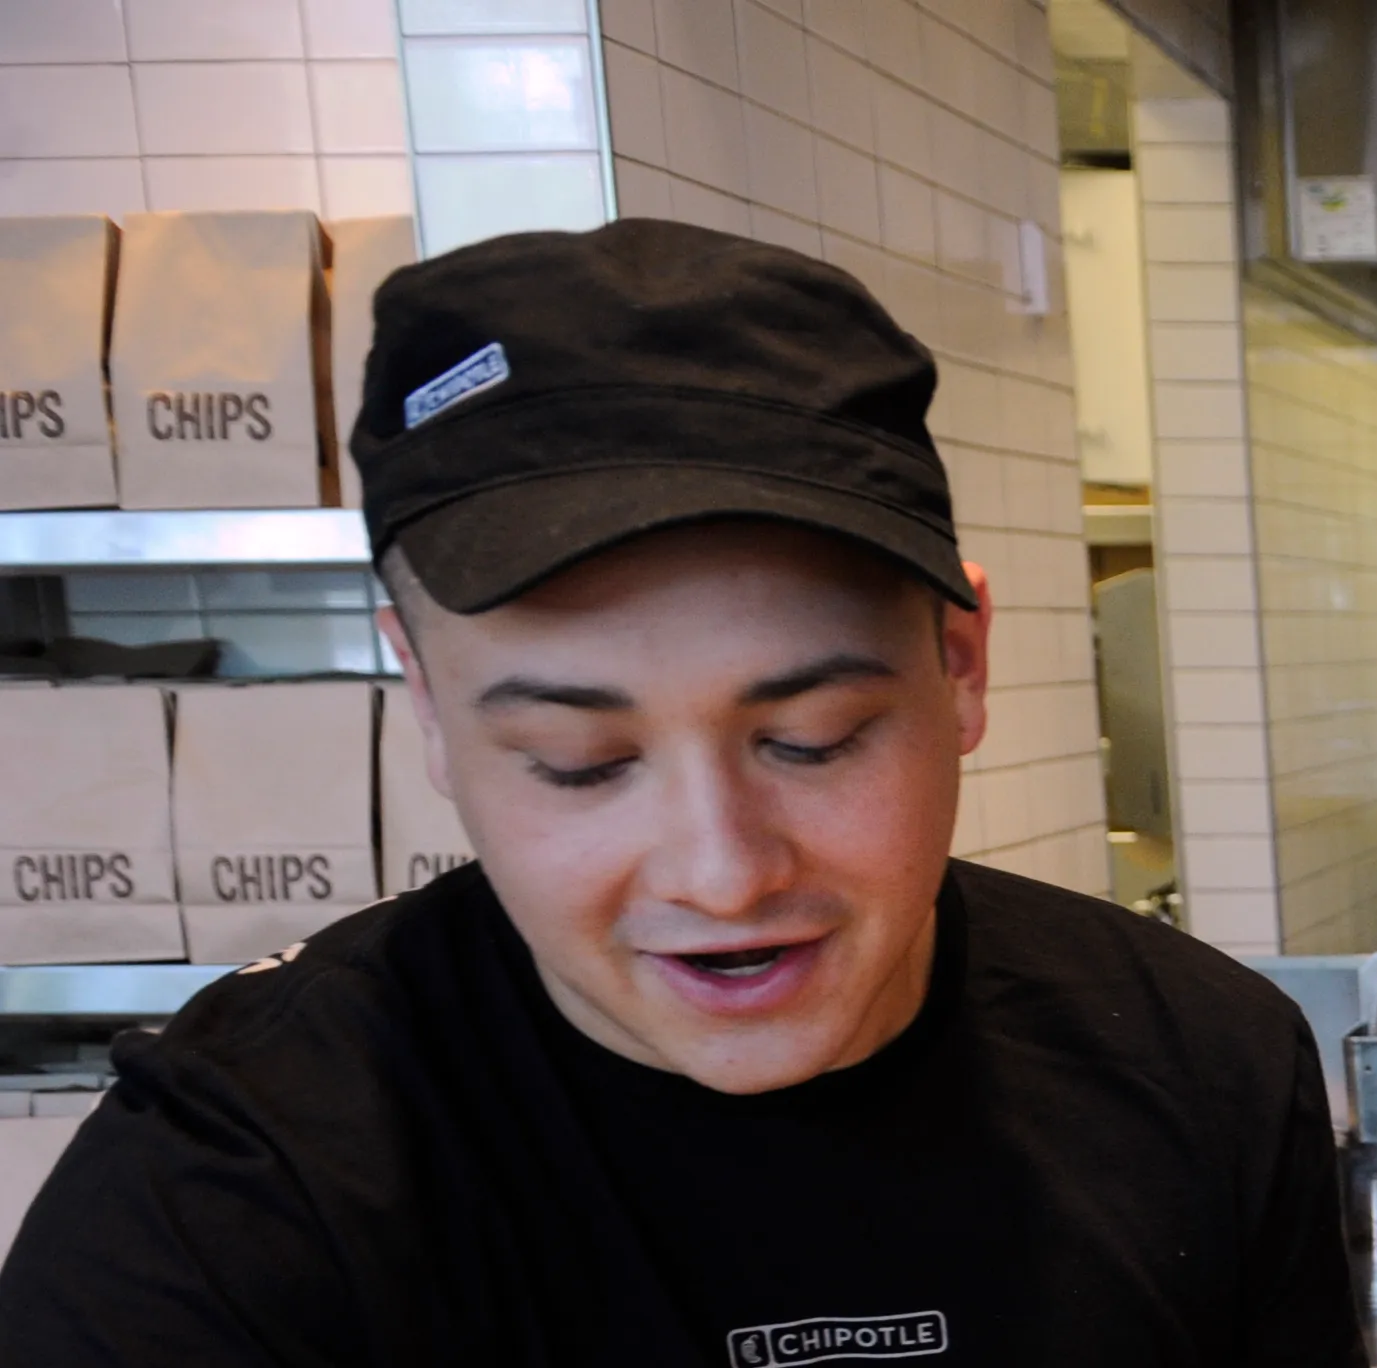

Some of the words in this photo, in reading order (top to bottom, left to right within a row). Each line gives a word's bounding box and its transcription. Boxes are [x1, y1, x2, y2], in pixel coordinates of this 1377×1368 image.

[0, 390, 65, 439] IPS
[146, 392, 272, 441] CHIPS
[13, 853, 134, 901] CHIPS
[211, 854, 332, 901] CHIPS
[778, 1322, 936, 1355] CHIPOTLE
